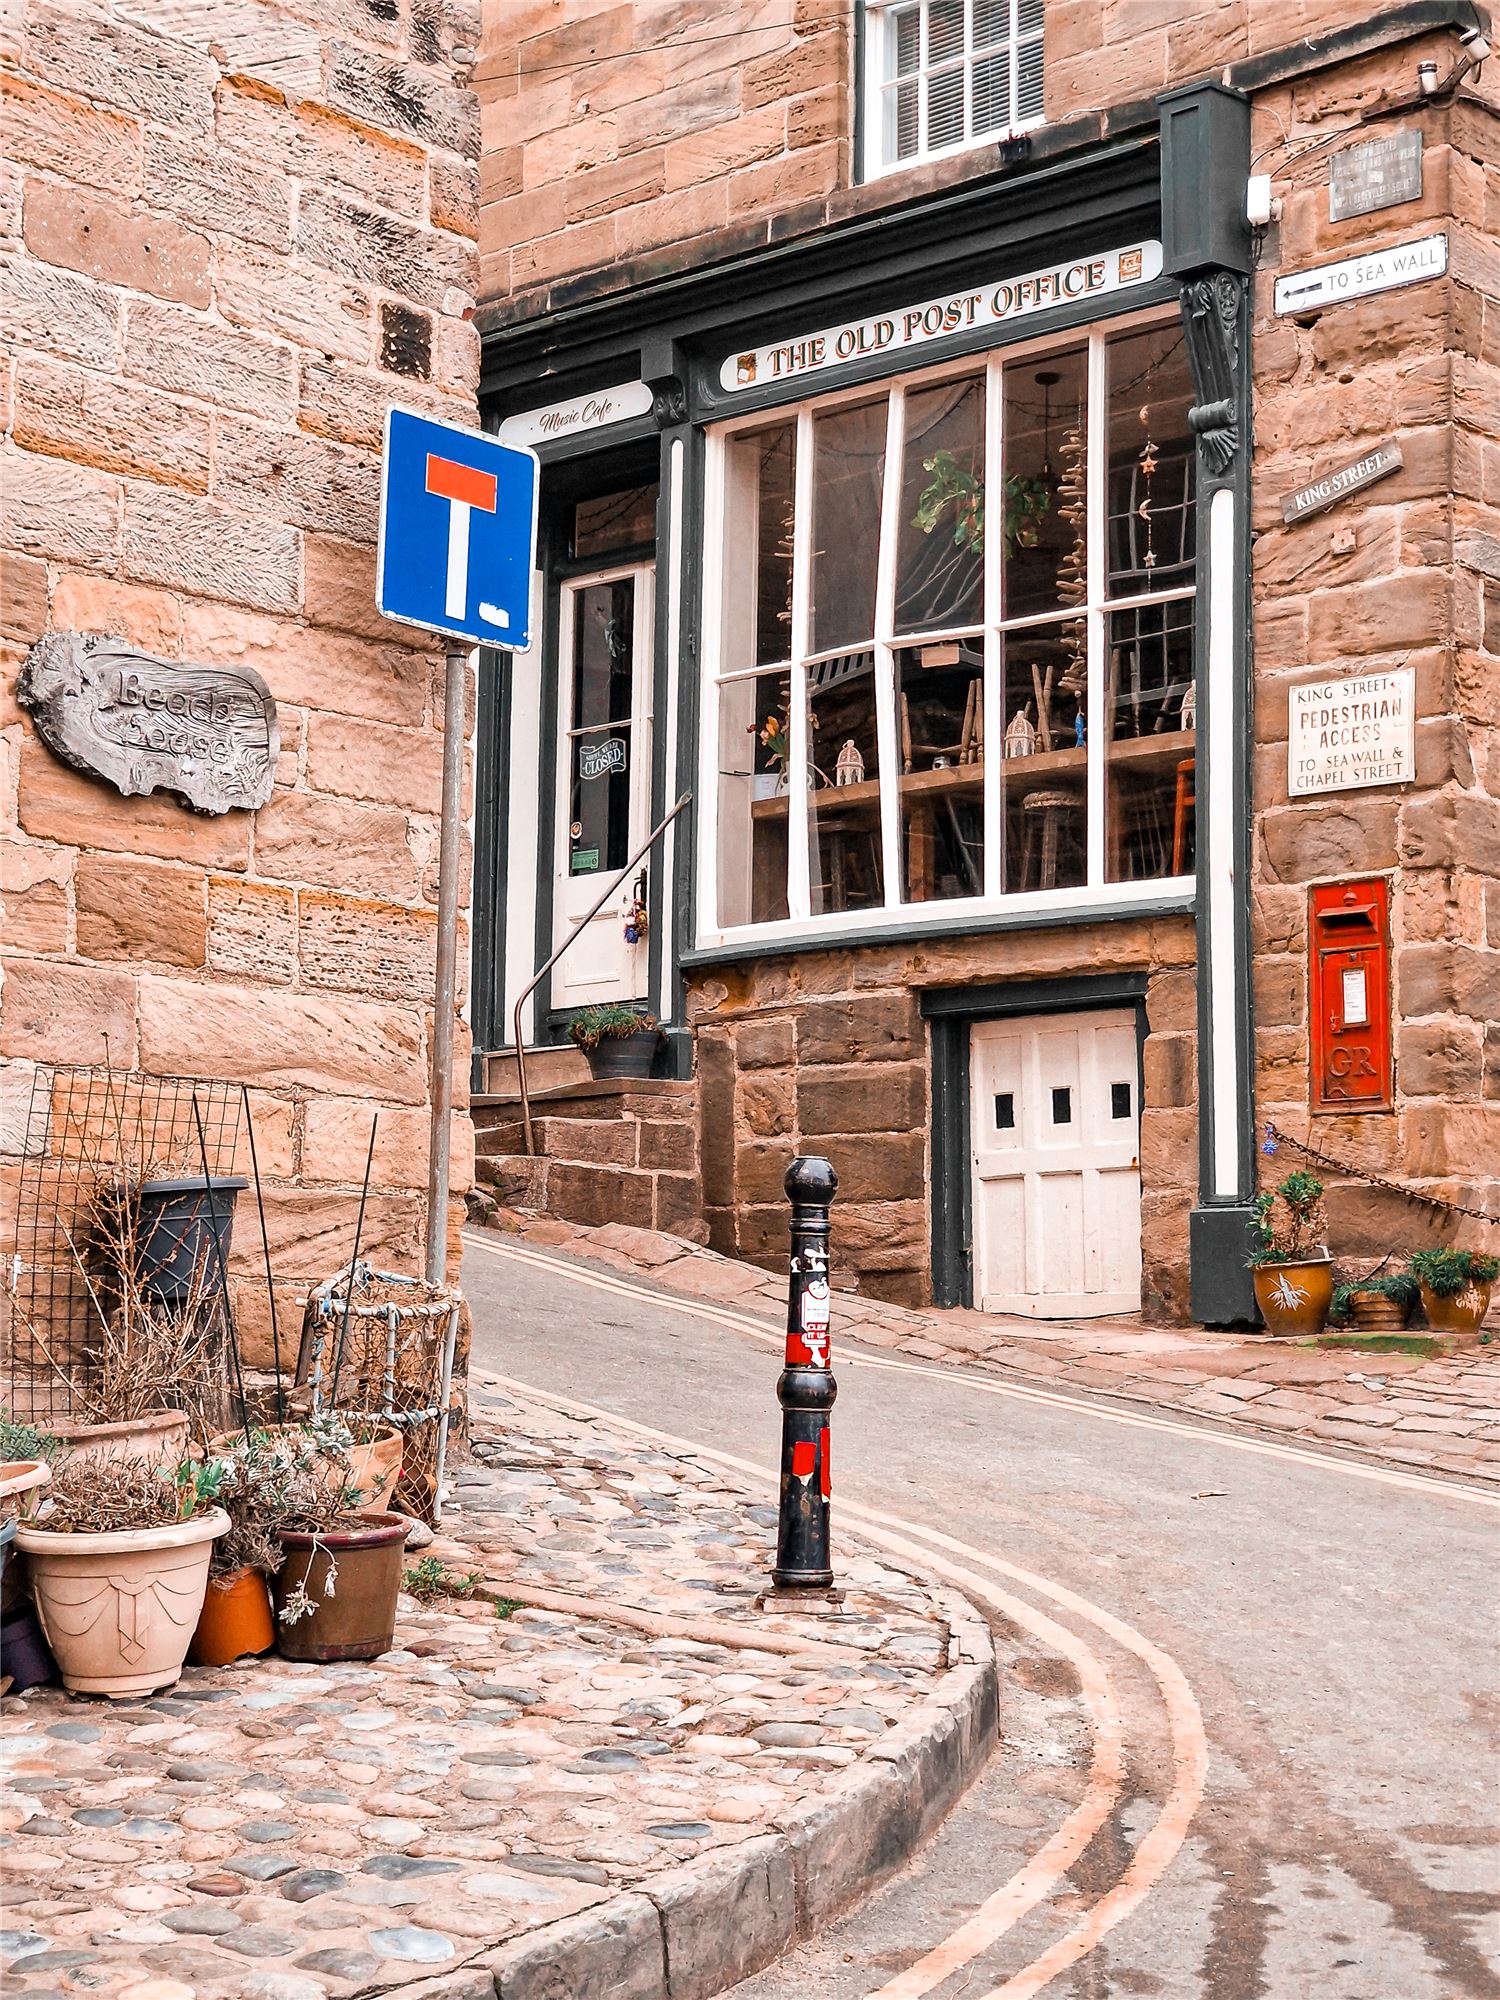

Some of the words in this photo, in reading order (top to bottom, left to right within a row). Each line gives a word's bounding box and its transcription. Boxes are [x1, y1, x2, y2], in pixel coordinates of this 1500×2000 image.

[1328, 272, 1349, 290] TO
[1356, 263, 1386, 283] SEA
[1393, 249, 1438, 273] WALL
[766, 337, 827, 376] THE
[835, 320, 895, 359] OLD
[902, 294, 982, 341] POST
[991, 260, 1107, 317] OFFICE
[539, 409, 579, 433] Music
[1294, 480, 1331, 512] KING
[1331, 451, 1383, 491] STREET
[1297, 686, 1333, 703] KING
[1343, 678, 1389, 697] STREET
[1300, 697, 1401, 729] PEDESTRIAN
[1320, 723, 1380, 748] ACCESS
[585, 748, 621, 775] CLOSED
[1298, 759, 1316, 772] TO
[1392, 747, 1403, 759] &
[1297, 771, 1345, 788] CHAPEL
[1354, 762, 1402, 781] STREET
[1329, 1046, 1377, 1077] GR
